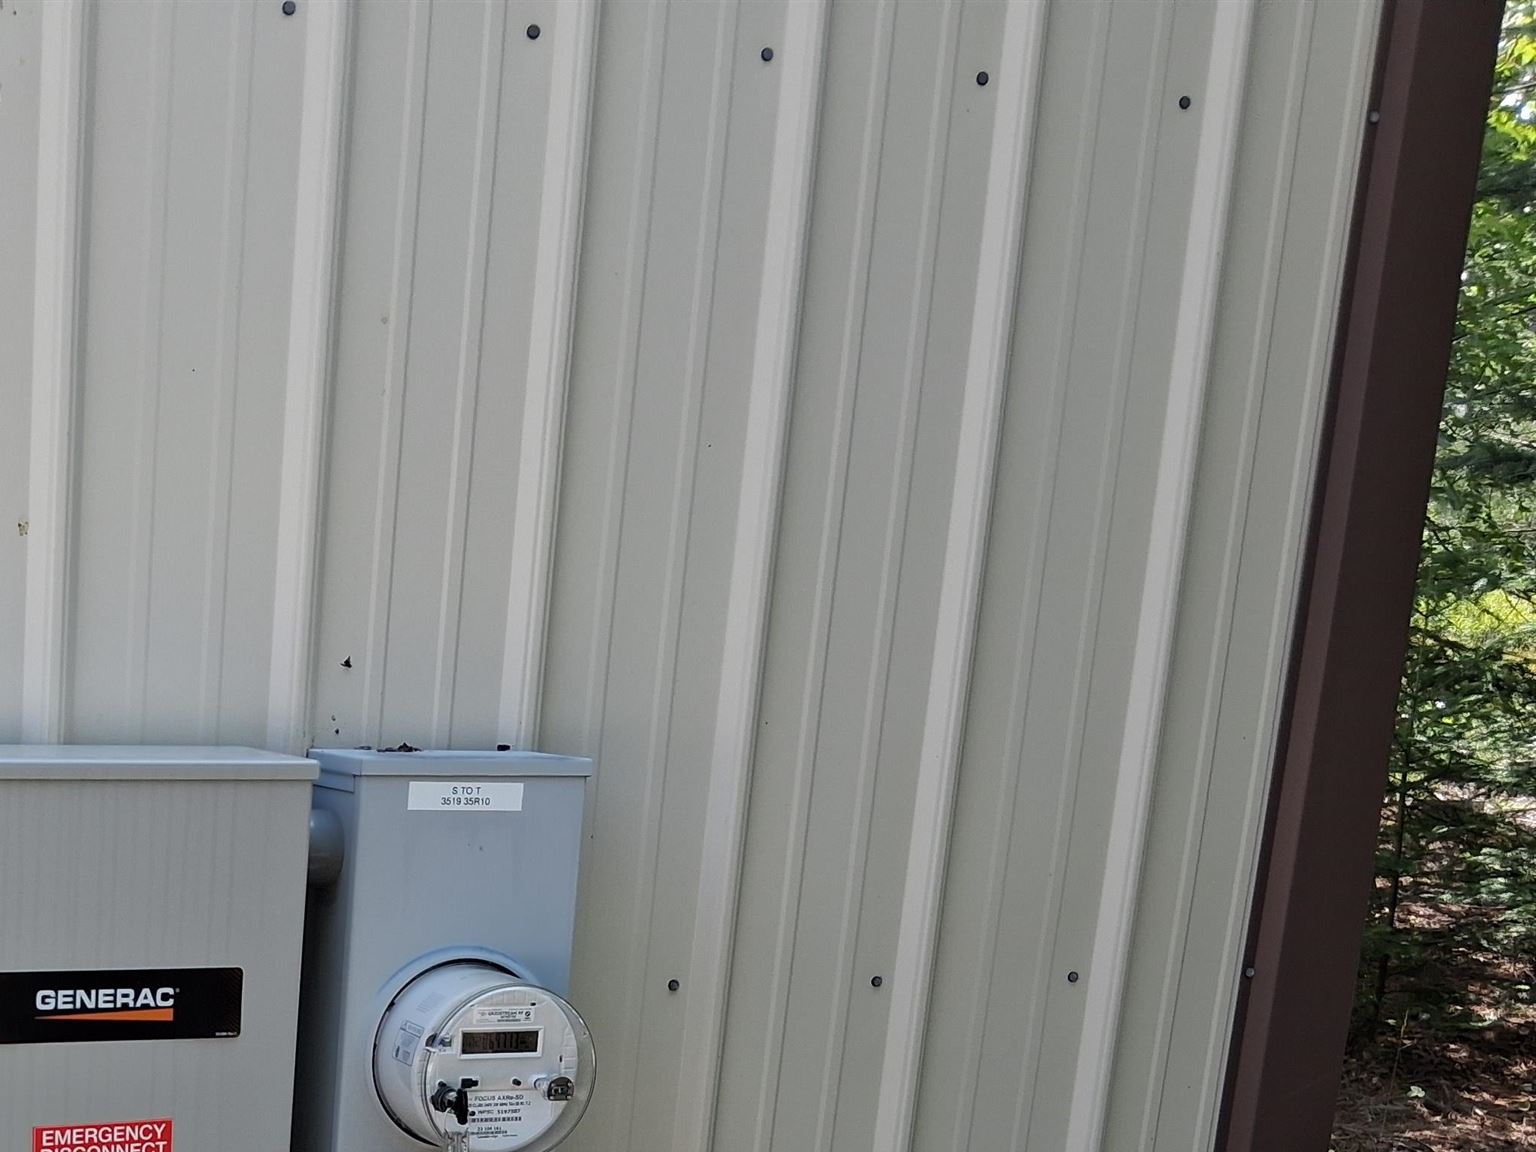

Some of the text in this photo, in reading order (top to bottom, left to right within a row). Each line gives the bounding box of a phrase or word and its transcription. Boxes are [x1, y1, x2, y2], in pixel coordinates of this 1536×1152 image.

[452, 786, 482, 795] S TO T
[441, 797, 491, 806] 3519 35R10
[35, 987, 175, 1012] GENERAC
[42, 1123, 167, 1147] EMERGENCY
